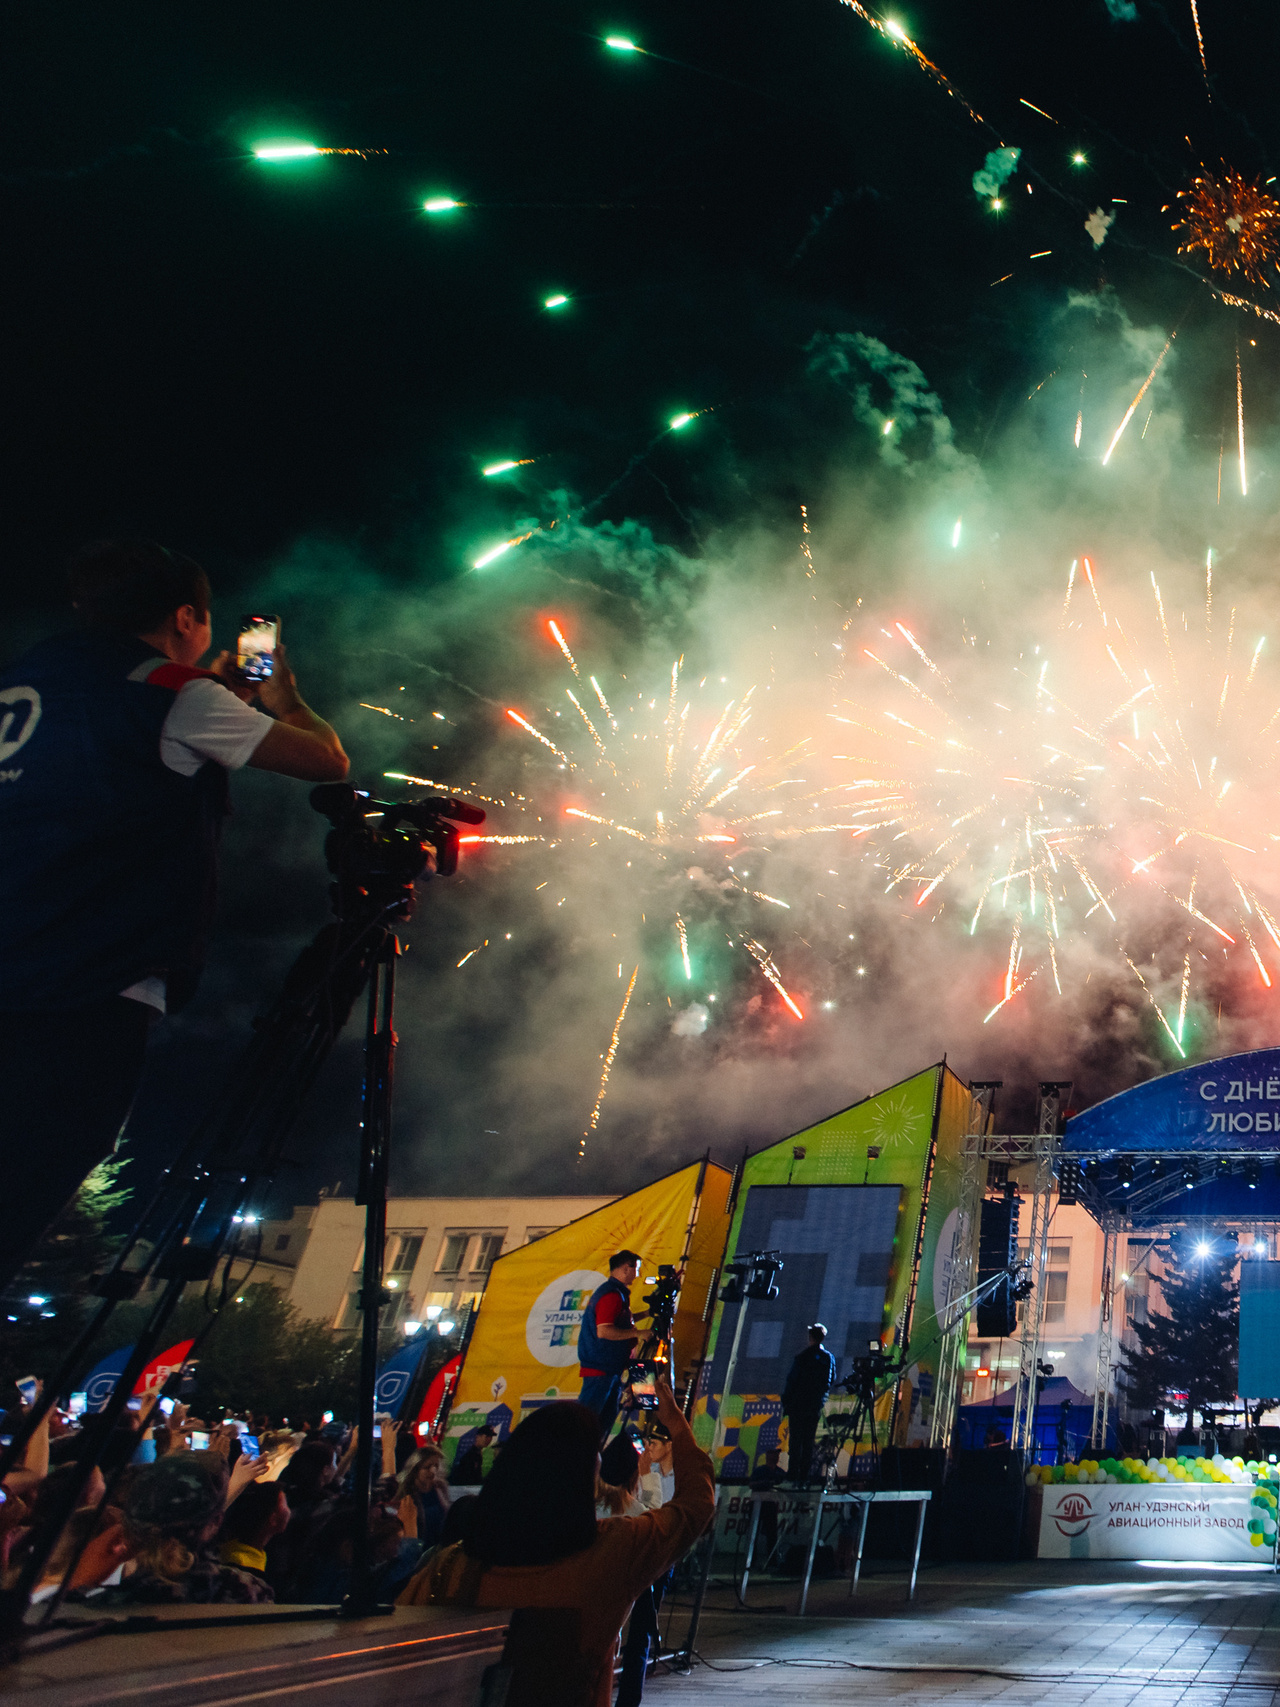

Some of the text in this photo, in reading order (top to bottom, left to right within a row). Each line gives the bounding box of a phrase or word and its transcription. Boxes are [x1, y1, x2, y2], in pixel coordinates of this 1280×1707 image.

[1199, 1080, 1218, 1101] С
[1108, 1501, 1210, 1513] УЛАН-УДЭНСКИЙ
[1107, 1515, 1245, 1529] АВИАЦИОННЫЙ ЗАВОД
